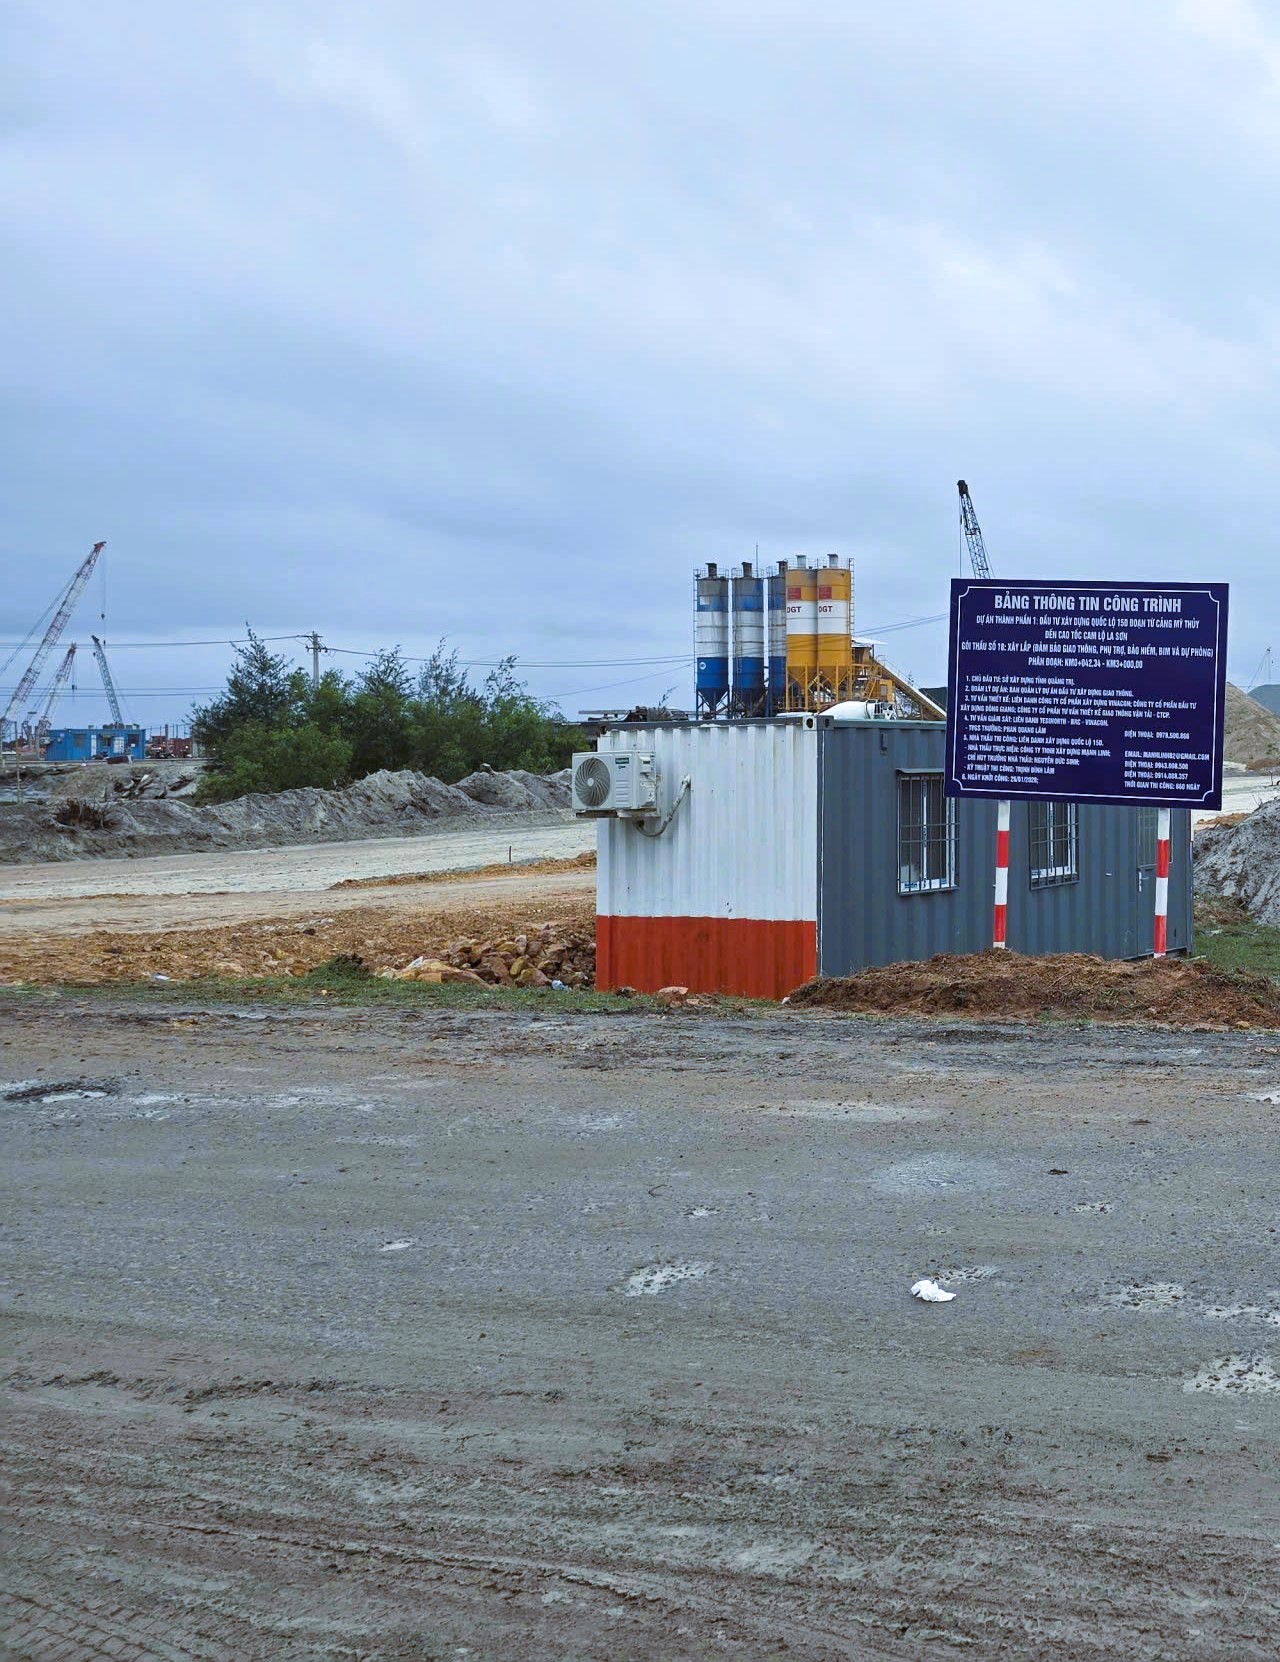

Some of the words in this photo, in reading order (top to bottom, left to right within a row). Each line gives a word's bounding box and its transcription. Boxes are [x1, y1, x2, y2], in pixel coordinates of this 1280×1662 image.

[995, 591, 1029, 609] BẢNG
[1033, 594, 1074, 610] THÔNG
[1079, 597, 1099, 610] TIN
[1104, 595, 1138, 611] CÔNG
[1143, 596, 1181, 612] TRÌNH
[977, 616, 985, 625] DỰ
[986, 614, 993, 623] ÁN
[995, 615, 1014, 624] THÀNH
[1015, 615, 1031, 625] PHẦN
[1040, 615, 1051, 625] ĐẦU
[1053, 616, 1061, 625] TƯ
[1061, 616, 1072, 625] XÂY
[1074, 617, 1089, 628] DỰNG
[1091, 615, 1107, 627] QUỐC
[1108, 618, 1115, 628] LỘ
[1117, 619, 1128, 627] 15D
[1130, 619, 1146, 629] ĐOẠN
[1147, 618, 1156, 627] TỪ
[1156, 617, 1172, 628] CẢNG
[1185, 618, 1199, 629] THỦY
[1045, 629, 1057, 638] ĐẾN
[1058, 631, 1070, 639] CAO
[1071, 628, 1082, 639] TỐC
[1084, 632, 1096, 640] CAM
[1098, 630, 1105, 642] LỘ
[1107, 632, 1114, 640] LA
[1116, 632, 1127, 640] SƠN
[962, 641, 971, 650] GÓI
[973, 640, 987, 650] THẦU
[989, 640, 996, 650] SỐ
[1008, 643, 1019, 651] XÂY
[1049, 642, 1061, 653] BẢO
[1063, 645, 1076, 653] GIAO
[1100, 646, 1112, 656] PHỤ
[1127, 644, 1139, 655] BẢO
[1159, 648, 1170, 656] BIM
[1172, 646, 1180, 656] VÀ
[1181, 649, 1190, 658] DỰ
[1029, 657, 1044, 666] PHÂN
